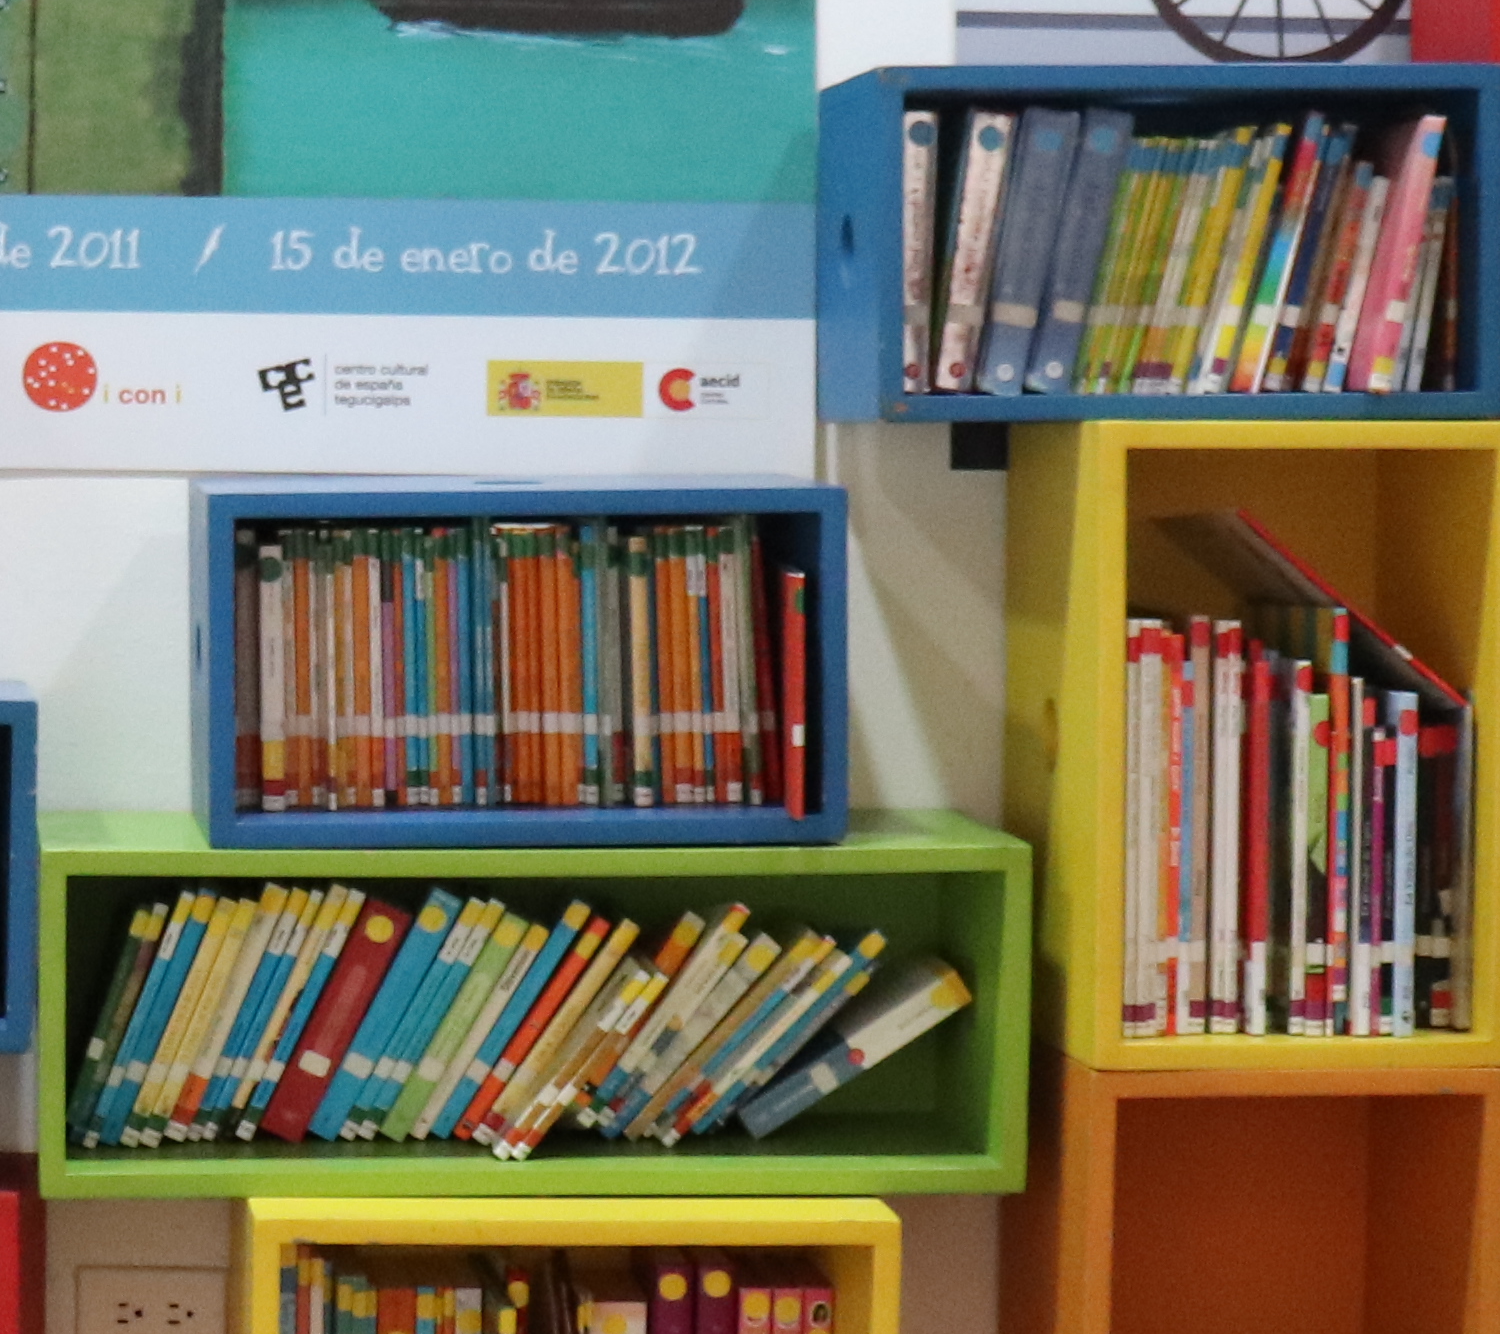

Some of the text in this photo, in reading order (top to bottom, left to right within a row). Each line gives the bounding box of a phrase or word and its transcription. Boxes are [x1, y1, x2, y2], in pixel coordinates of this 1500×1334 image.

[47, 226, 142, 270] 2011
[269, 229, 314, 271] 15
[332, 226, 386, 273] de
[400, 239, 513, 274] enero
[526, 229, 579, 275] de
[595, 232, 701, 276] 2012
[700, 373, 740, 388] aecid
